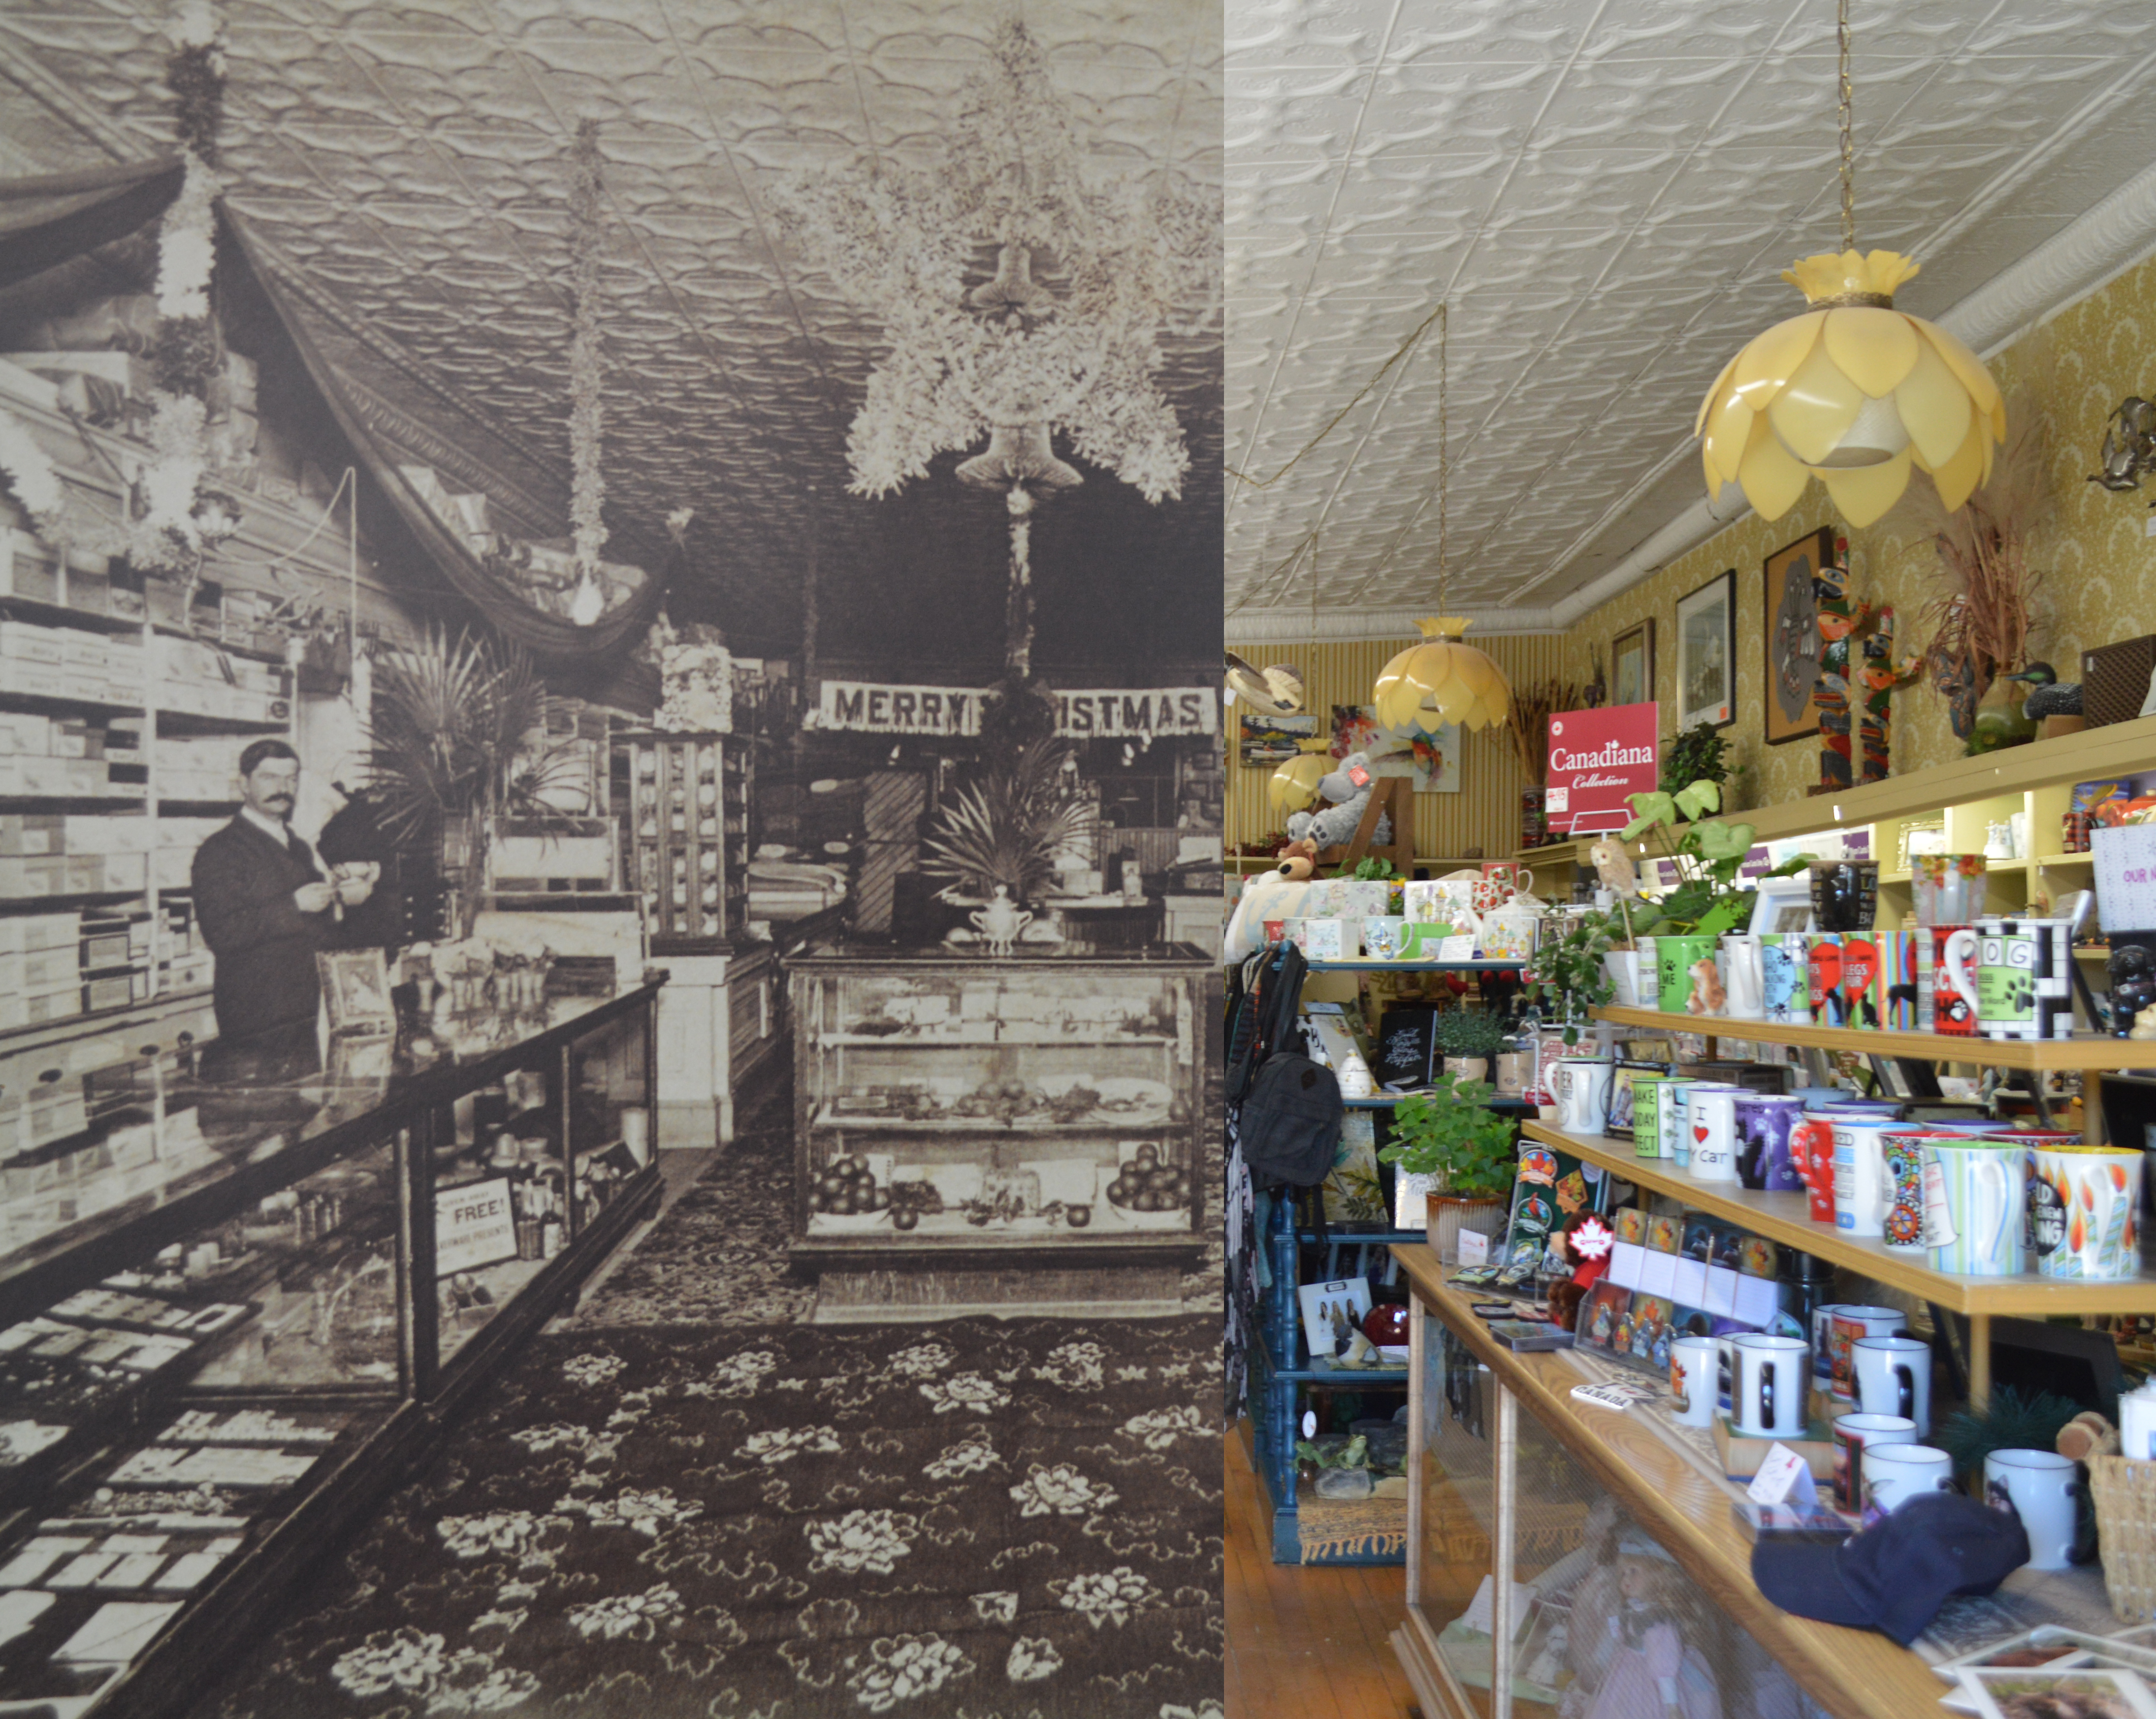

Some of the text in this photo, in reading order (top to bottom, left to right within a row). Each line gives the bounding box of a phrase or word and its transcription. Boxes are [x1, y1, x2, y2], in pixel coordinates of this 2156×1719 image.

[835, 689, 967, 729] MERRY
[1550, 739, 1654, 772] Canadiana
[1573, 773, 1629, 789] Collection
[2123, 868, 2147, 883] OUR
[1986, 941, 2028, 964] OG
[454, 1198, 505, 1224] FREE!
[1577, 1386, 1628, 1407] CANADA
